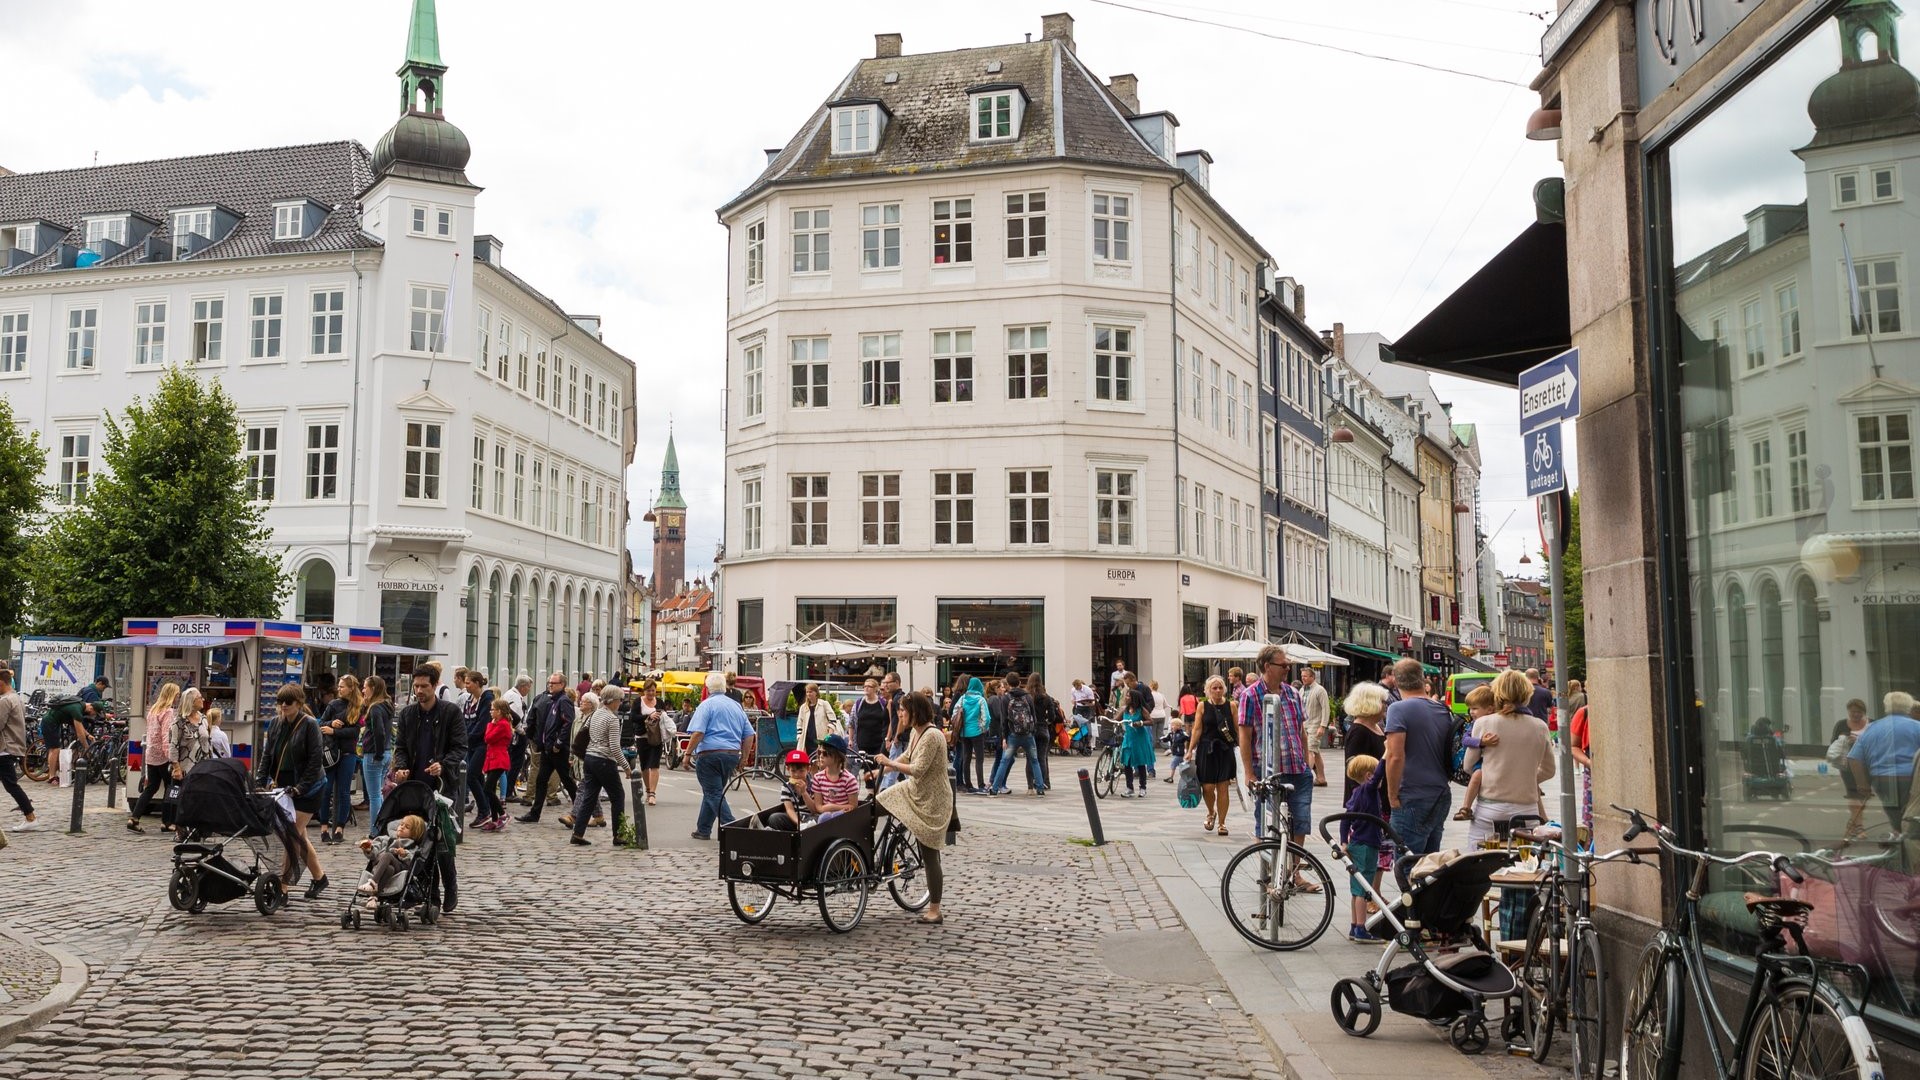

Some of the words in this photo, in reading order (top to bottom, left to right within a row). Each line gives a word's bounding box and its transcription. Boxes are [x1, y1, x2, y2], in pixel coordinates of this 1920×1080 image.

[1523, 378, 1566, 414] Ensrettet
[1530, 470, 1559, 490] undtaget
[1107, 569, 1136, 580] EUROPA
[377, 581, 409, 590] HØJBRO
[411, 583, 438, 591] PLADS
[172, 623, 211, 634] PØLSER
[311, 626, 340, 640] PØLSER
[36, 645, 83, 653] www.tim.dk
